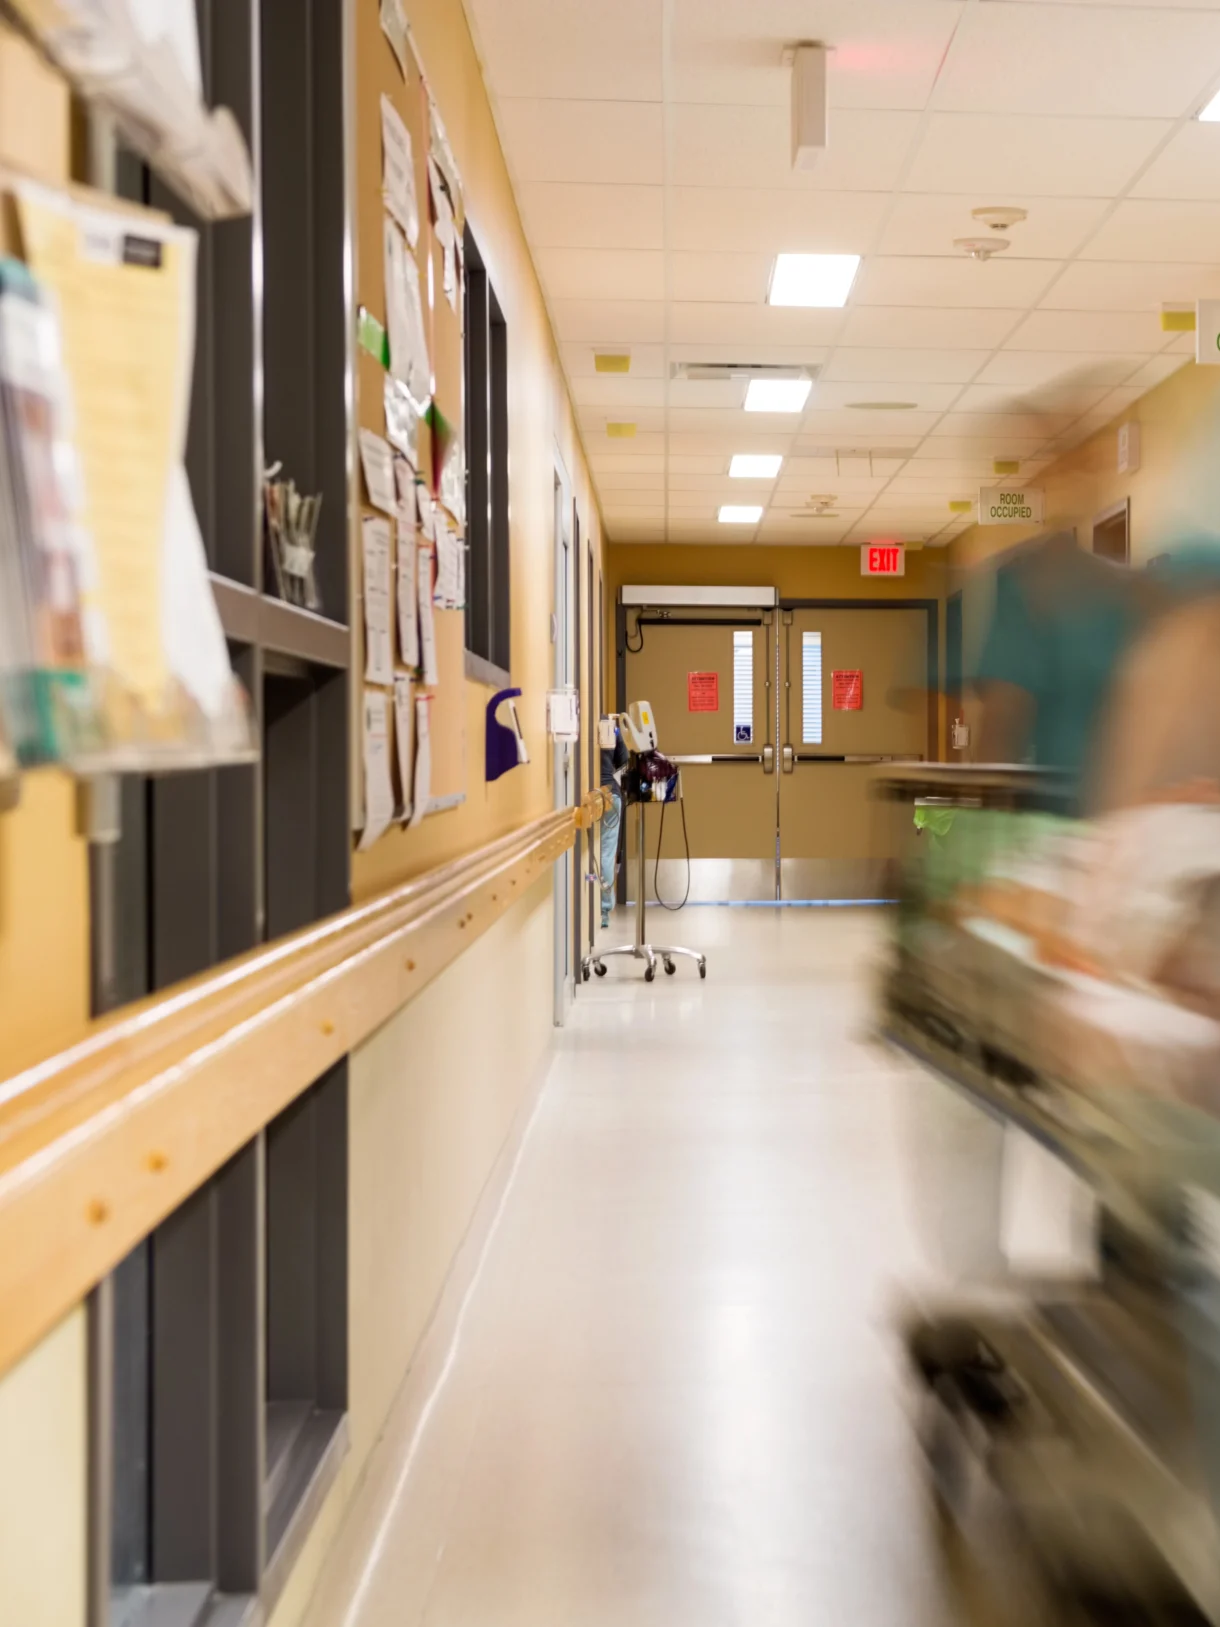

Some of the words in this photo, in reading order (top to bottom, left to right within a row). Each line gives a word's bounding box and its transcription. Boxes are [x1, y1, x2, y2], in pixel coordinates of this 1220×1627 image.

[1000, 493, 1024, 505] ROOM
[990, 506, 1031, 518] OCCUPIED
[869, 547, 899, 572] EXIT
